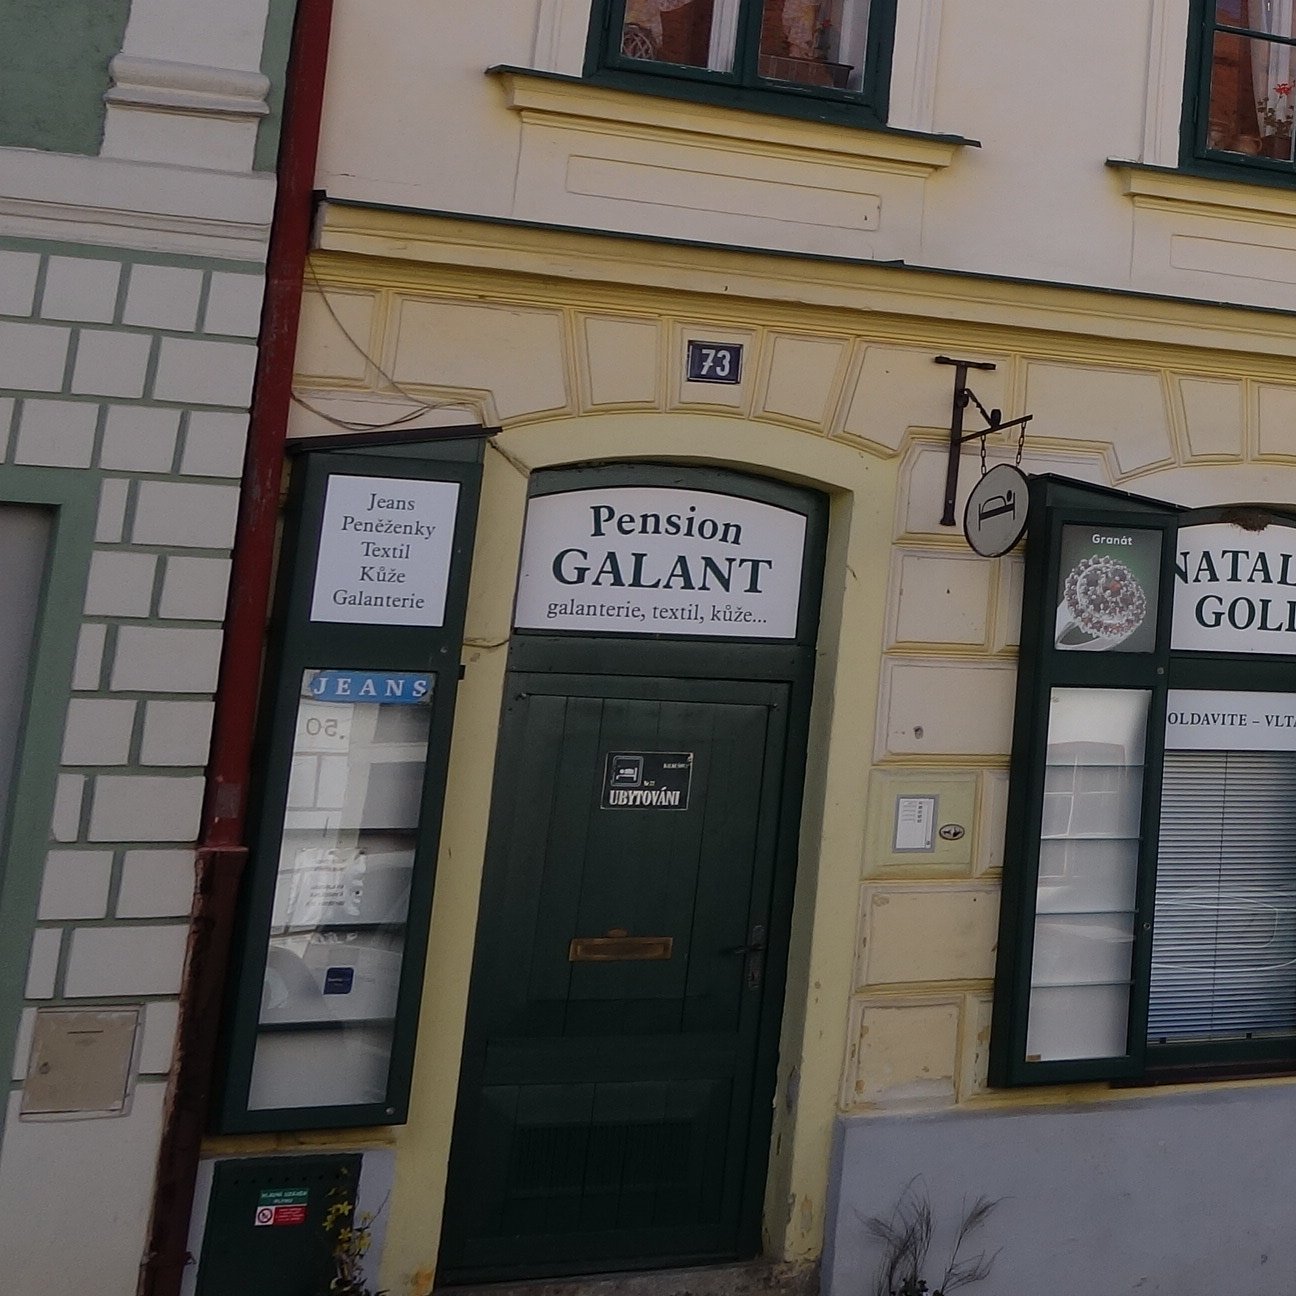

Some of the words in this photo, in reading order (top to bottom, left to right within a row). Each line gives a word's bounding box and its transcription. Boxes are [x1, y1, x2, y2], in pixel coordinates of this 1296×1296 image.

[701, 348, 731, 377] 73
[367, 493, 416, 511] Jeans
[341, 516, 436, 540] Peněženky
[590, 505, 742, 546] Pension
[1092, 533, 1133, 546] Granát
[361, 541, 410, 560] Textil
[359, 565, 406, 583] Kůže
[552, 548, 773, 594] GALANT
[333, 589, 425, 609] Galanterie
[547, 599, 646, 622] galanterie,
[653, 604, 705, 624] textil,
[710, 605, 767, 624] kůže...
[314, 677, 428, 697] JEANS
[1167, 712, 1248, 726] OLDAVITE
